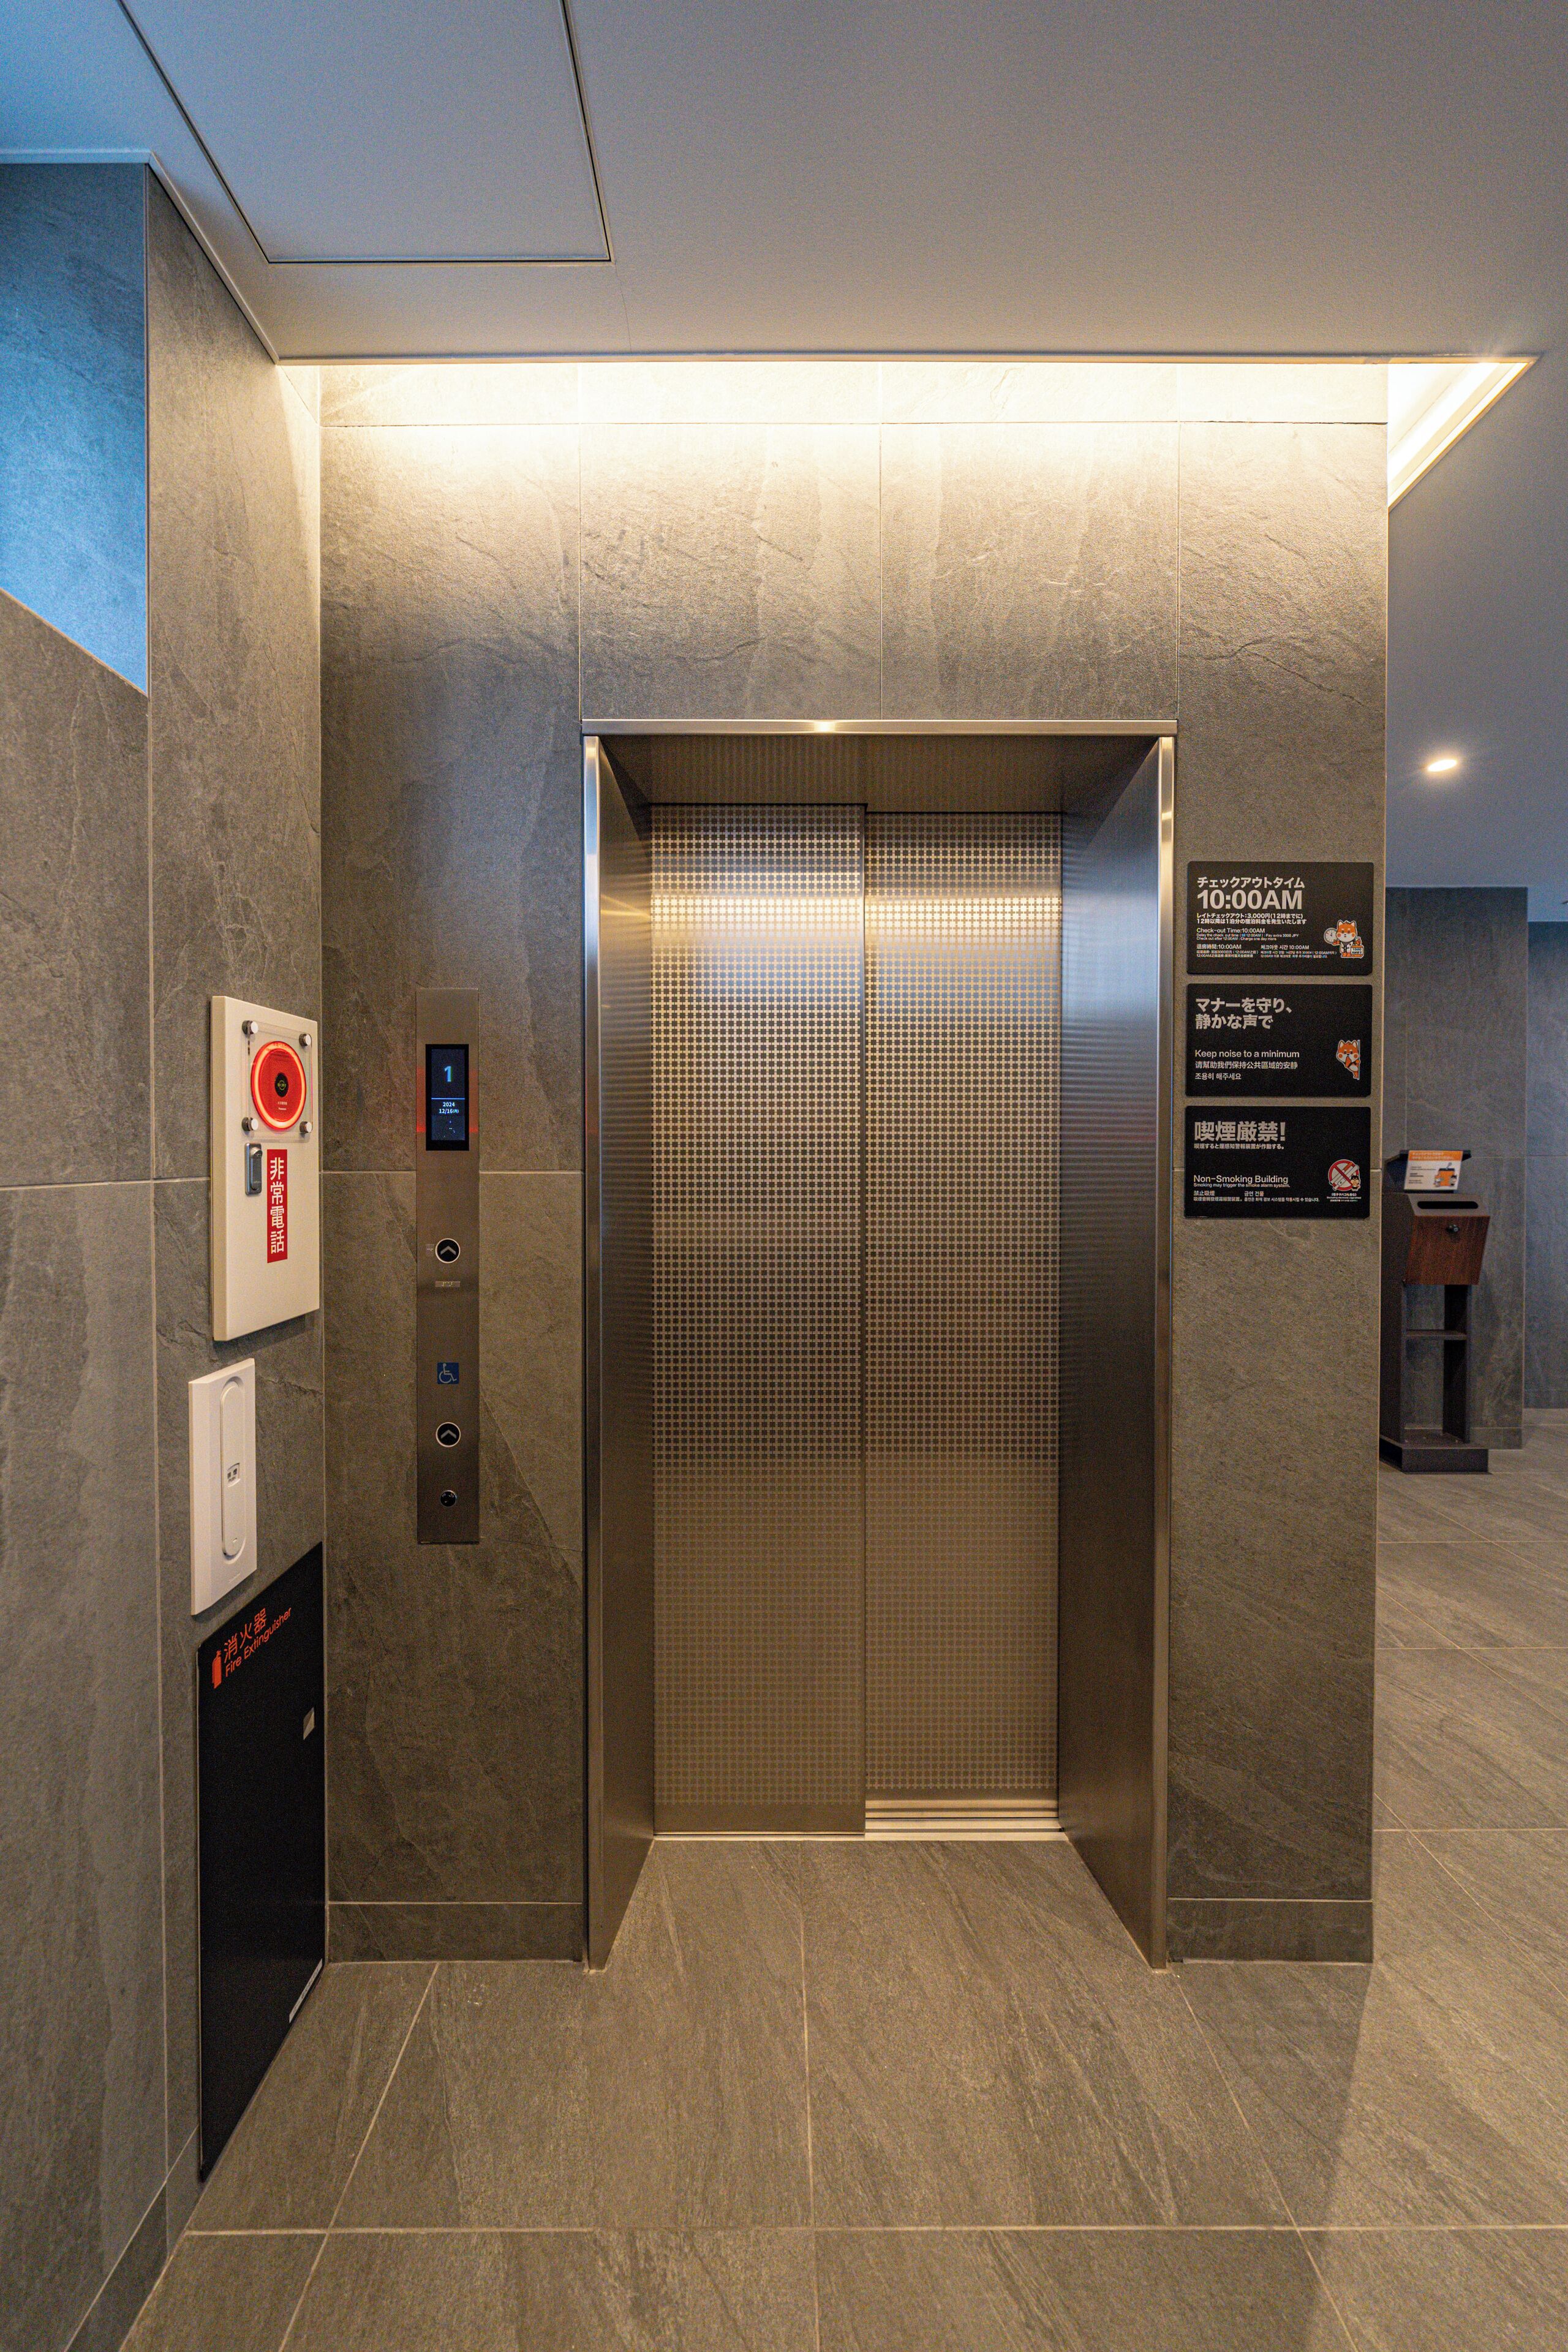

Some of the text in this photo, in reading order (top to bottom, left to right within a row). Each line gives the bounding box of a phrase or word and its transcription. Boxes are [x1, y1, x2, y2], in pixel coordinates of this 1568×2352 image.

[1197, 876, 1305, 888] チェックアウトタイム
[1197, 889, 1302, 910] 10:00AM
[1196, 997, 1292, 1014] マナーを守り、
[1195, 1014, 1274, 1030] 静かな声で
[1195, 1049, 1217, 1058] Keep
[444, 1066, 451, 1082] 1
[1194, 1121, 1286, 1142] 喫煙厳禁!
[1194, 1175, 1288, 1184] Non-Smoking Building
[270, 1157, 285, 1254] 非常電話
[224, 1607, 266, 1664] 消火器
[225, 1607, 292, 1677] Fire Extinguisher
